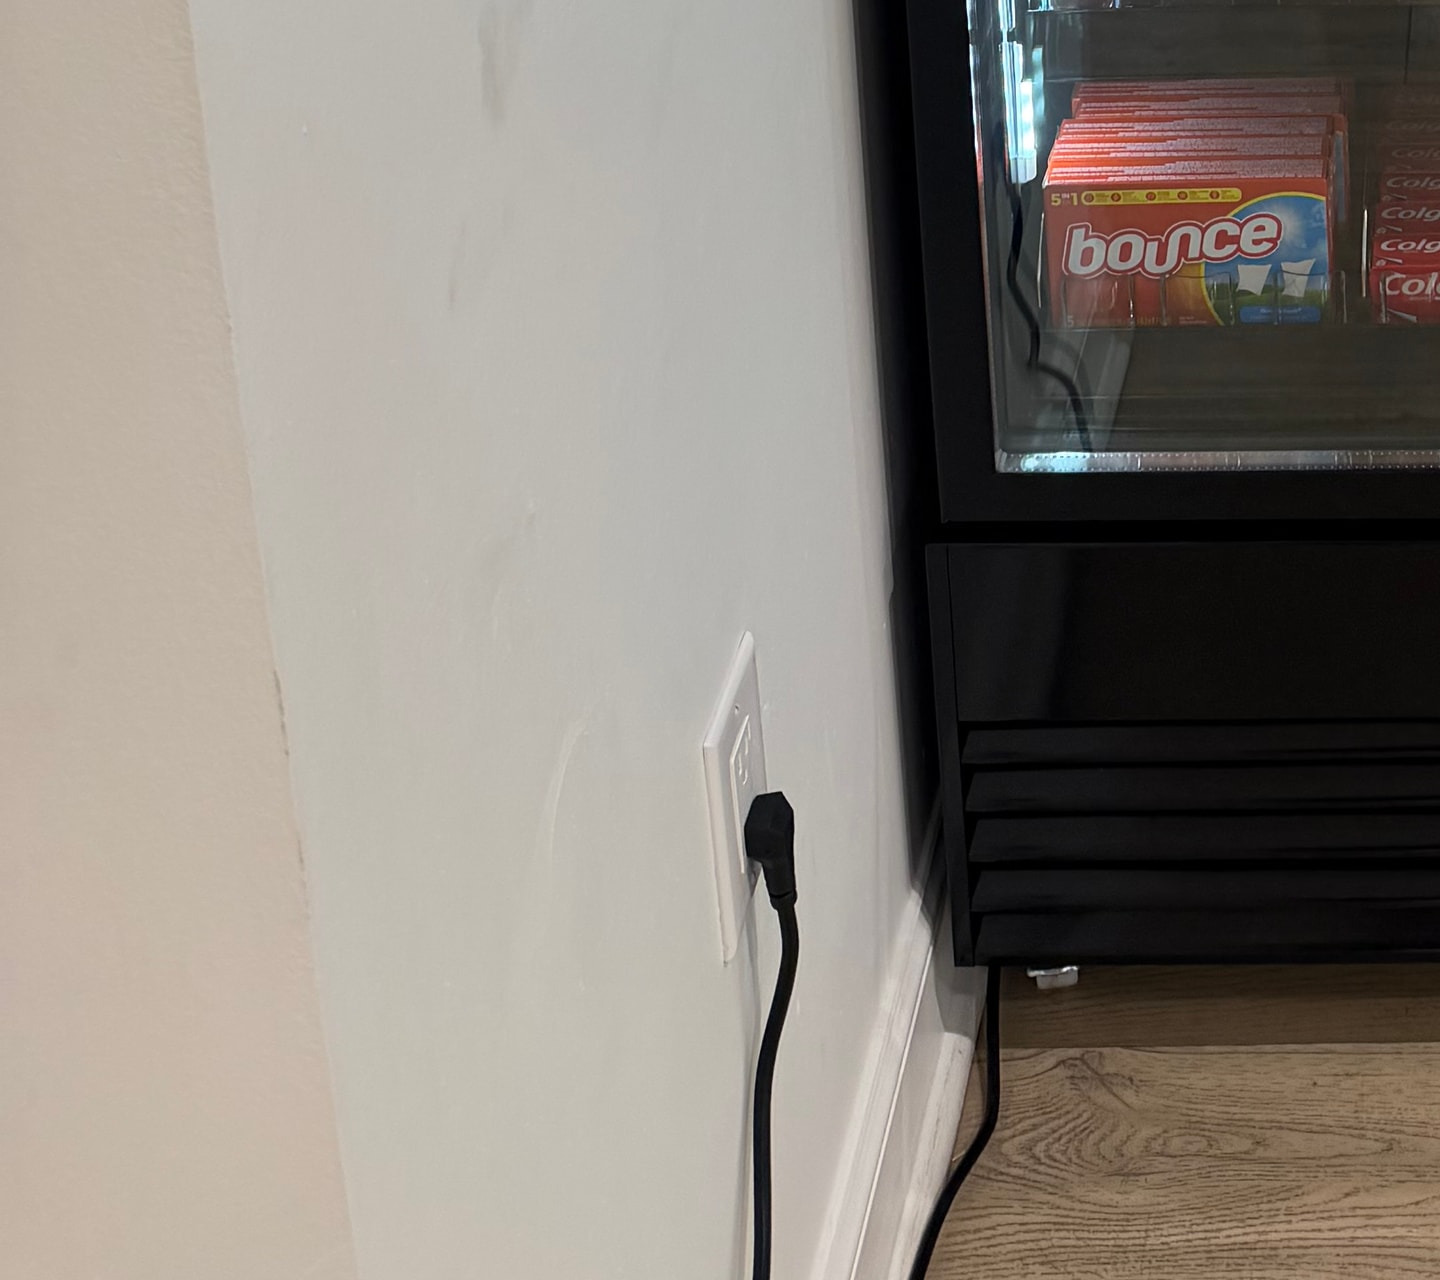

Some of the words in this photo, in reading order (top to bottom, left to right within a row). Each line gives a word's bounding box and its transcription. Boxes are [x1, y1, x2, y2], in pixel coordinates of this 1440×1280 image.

[1050, 192, 1062, 206] 5
[1070, 192, 1079, 206] 1
[1065, 214, 1281, 277] bounce
